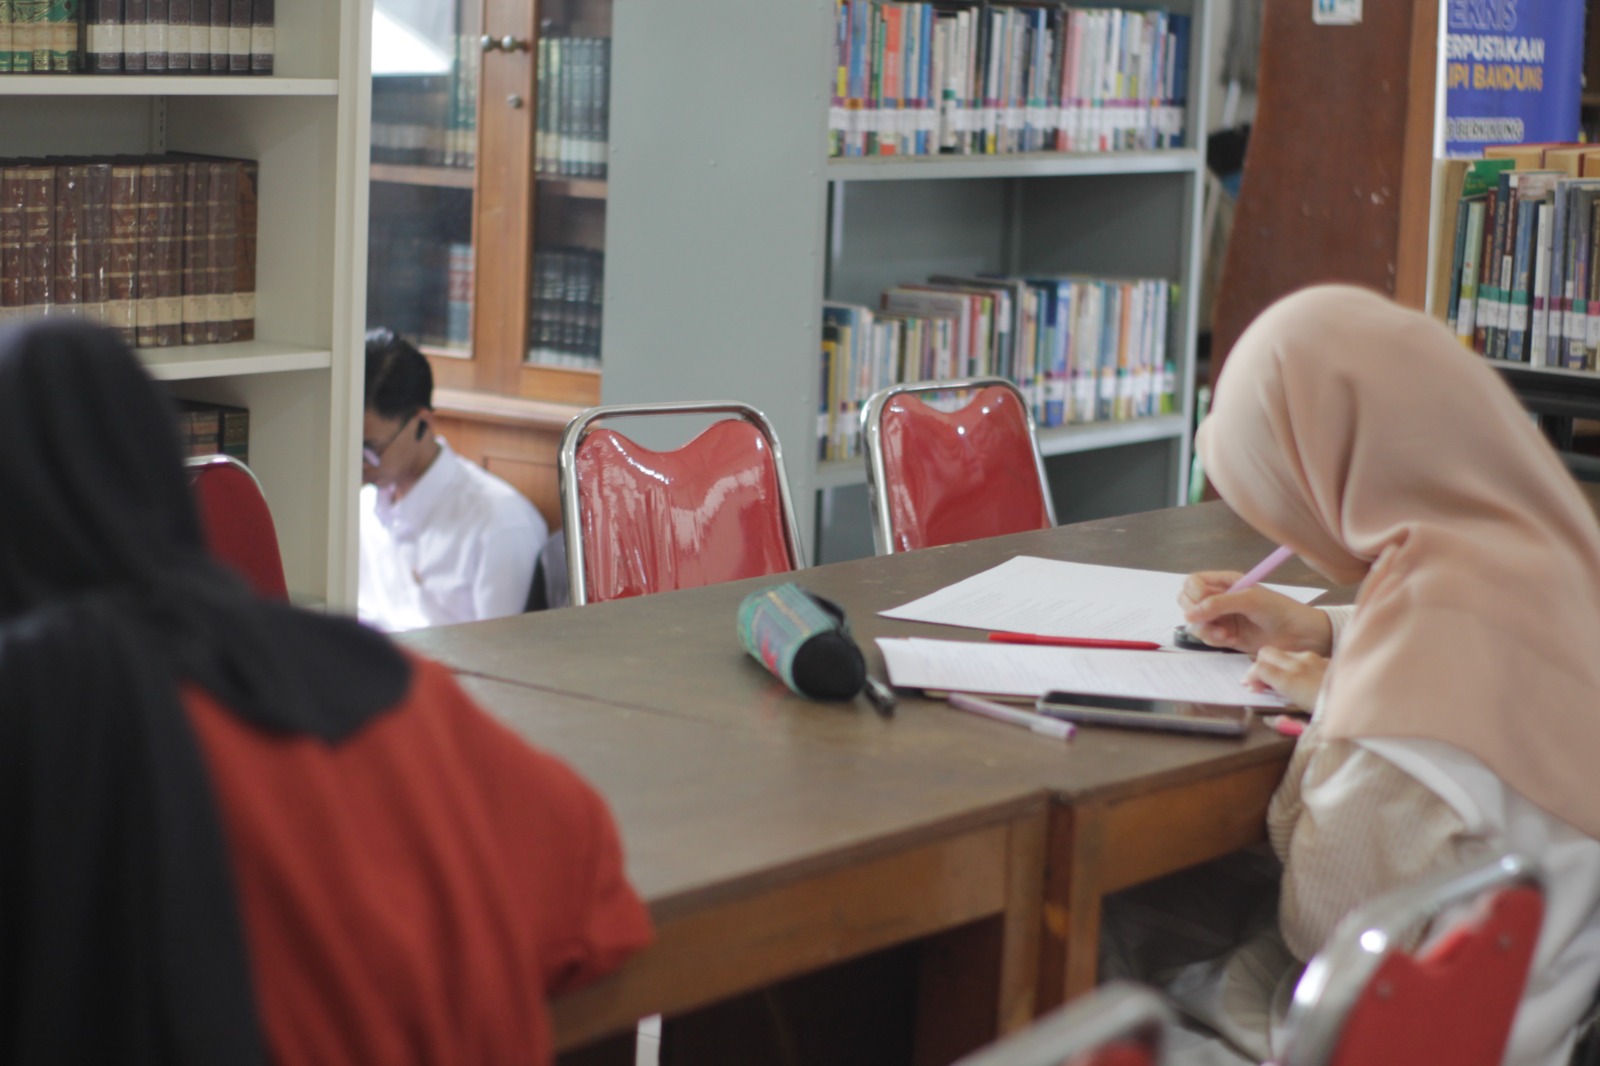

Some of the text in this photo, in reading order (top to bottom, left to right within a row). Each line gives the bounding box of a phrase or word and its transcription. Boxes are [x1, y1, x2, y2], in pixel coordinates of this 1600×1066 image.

[1447, 34, 1544, 63] ERPUSTAKAAN
[1448, 63, 1543, 91] IPI BANDUNG
